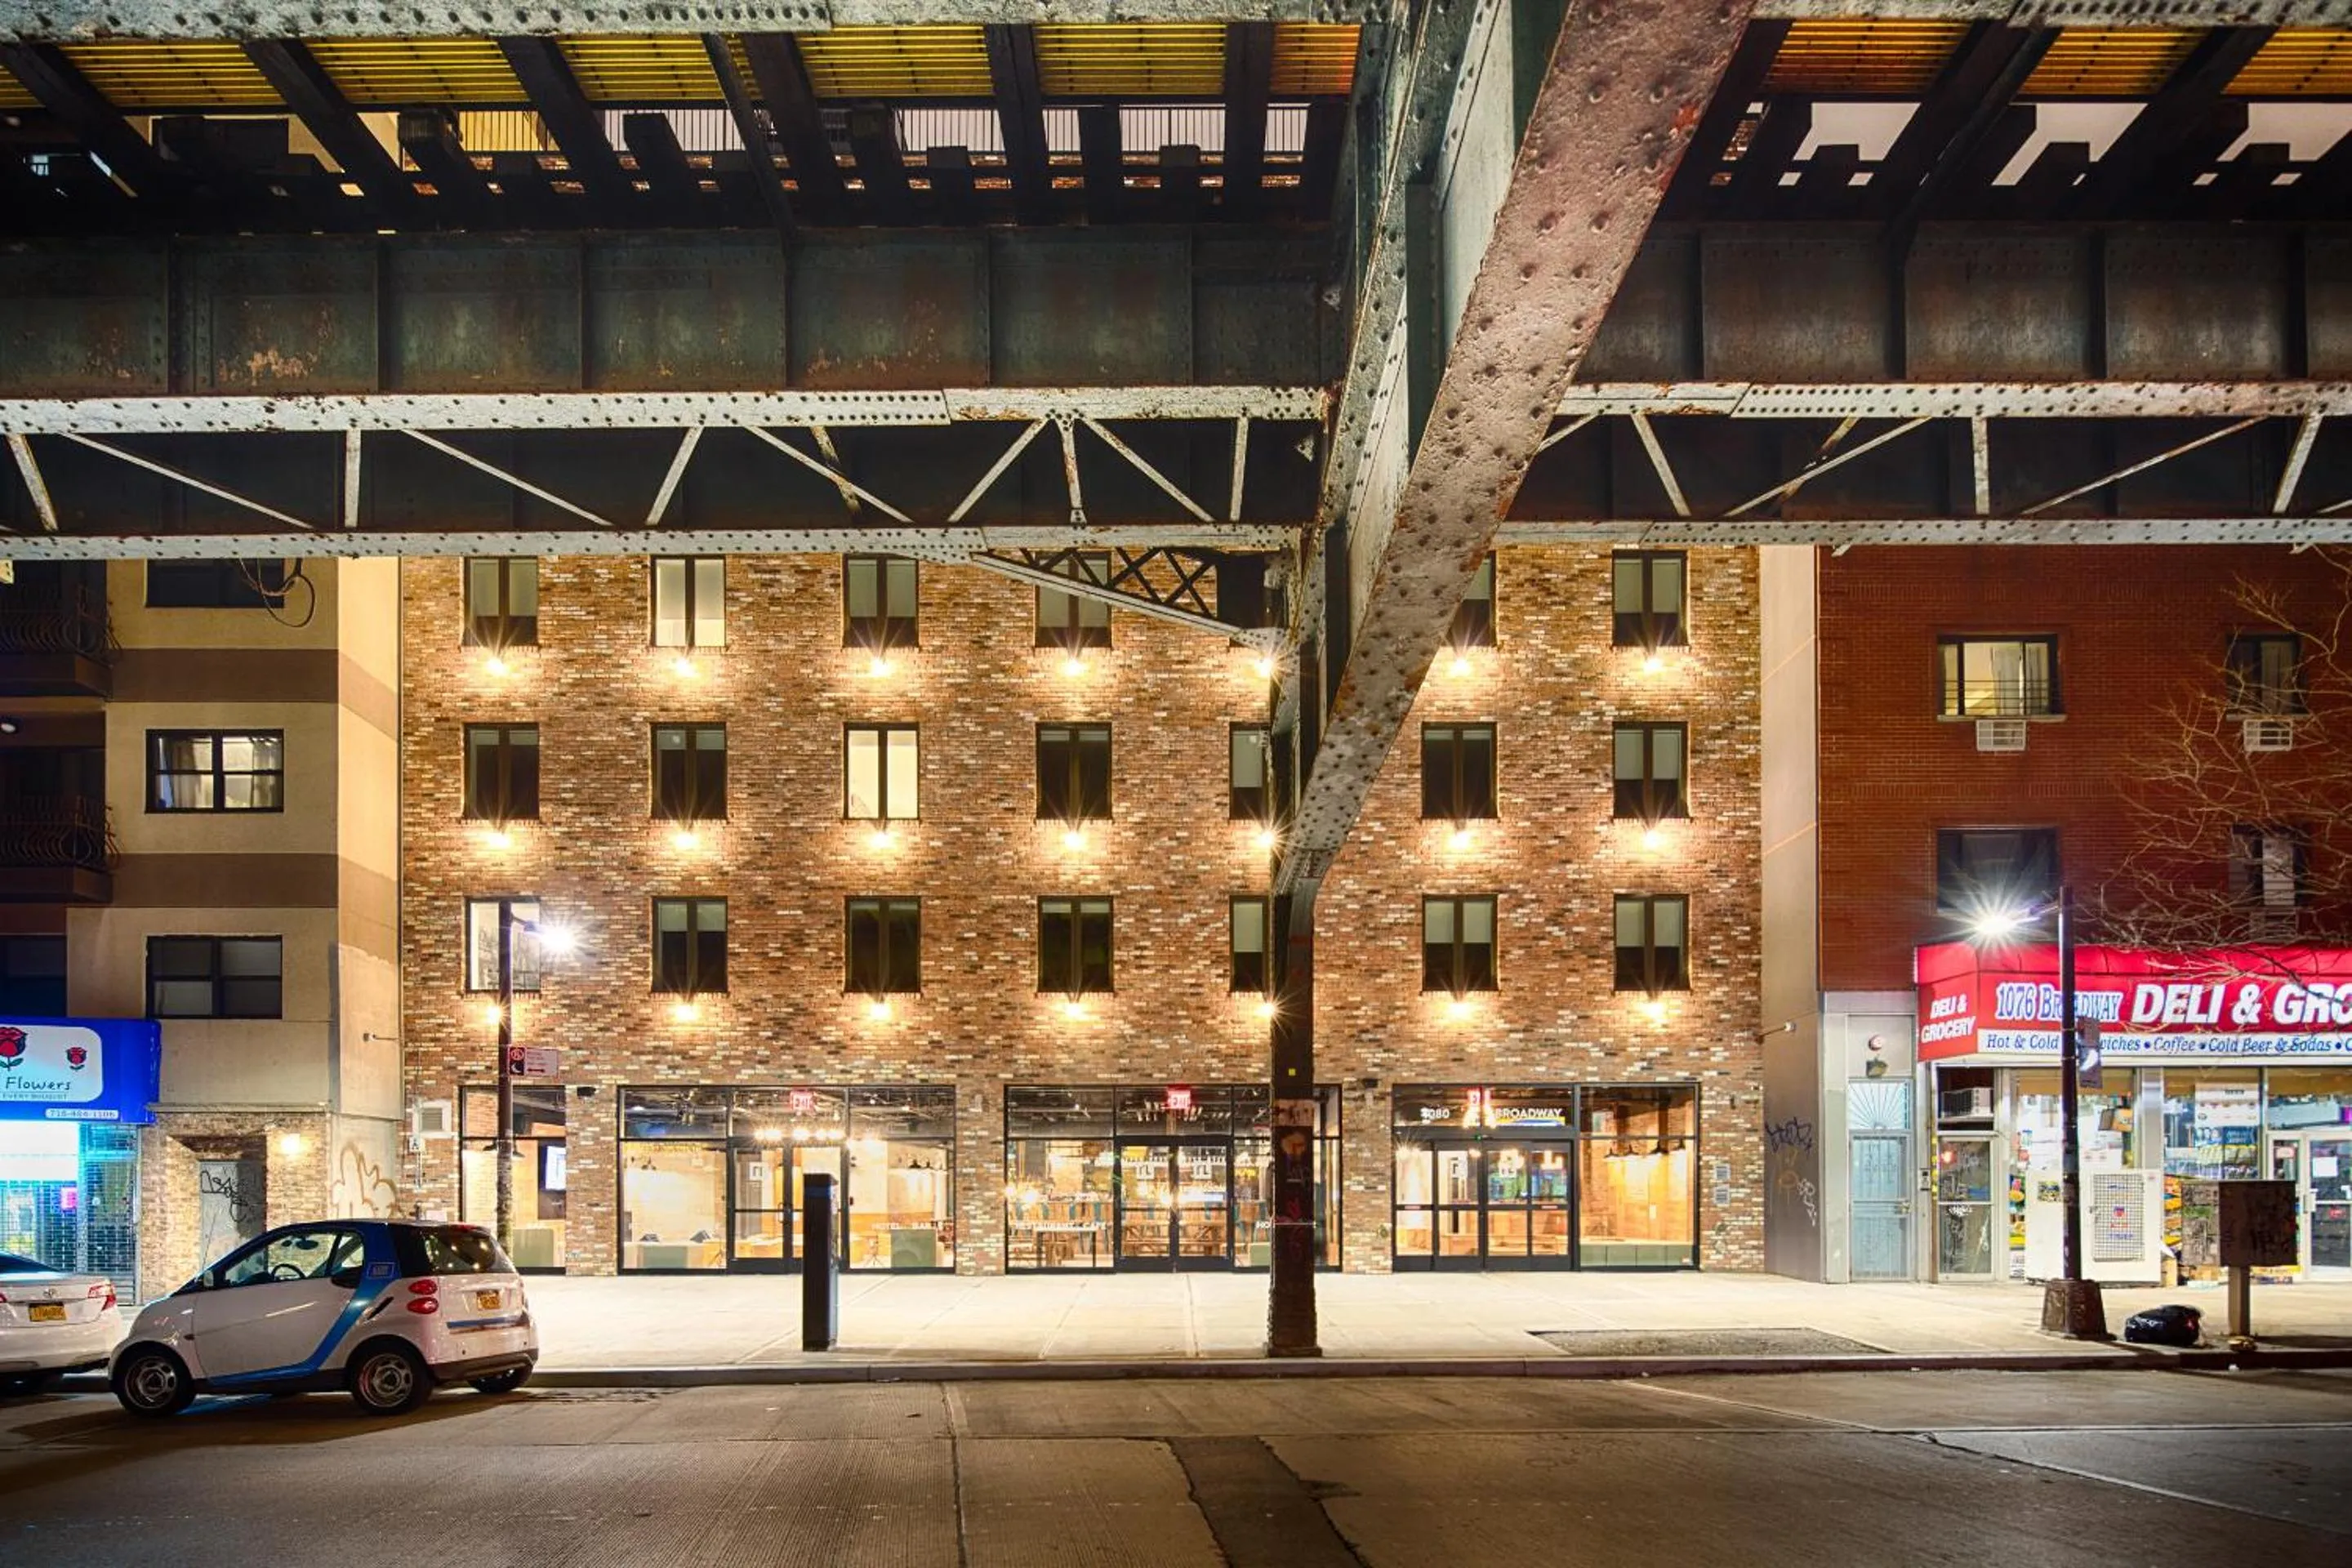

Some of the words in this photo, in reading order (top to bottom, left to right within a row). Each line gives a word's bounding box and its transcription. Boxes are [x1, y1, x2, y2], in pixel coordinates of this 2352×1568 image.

[1930, 996, 1957, 1019] DELI
[1958, 993, 1967, 1013] &
[1996, 983, 2036, 1020] 1076
[2038, 983, 2123, 1022] BRADWAY
[2131, 983, 2225, 1023] DELI
[2231, 983, 2262, 1024] &
[1922, 1016, 1976, 1043] GROCERY
[1987, 1034, 2010, 1049] Hot
[2014, 1035, 2025, 1049] &
[2029, 1034, 2059, 1049] Cold
[2154, 1036, 2196, 1054] Coffee
[2208, 1037, 2238, 1052] Cold
[2242, 1036, 2274, 1053] Beer
[2289, 1037, 2332, 1052] Sodas
[6, 1076, 71, 1090] Flowers
[1421, 1107, 1450, 1120] 080
[1495, 1107, 1562, 1119] BROADWAY
